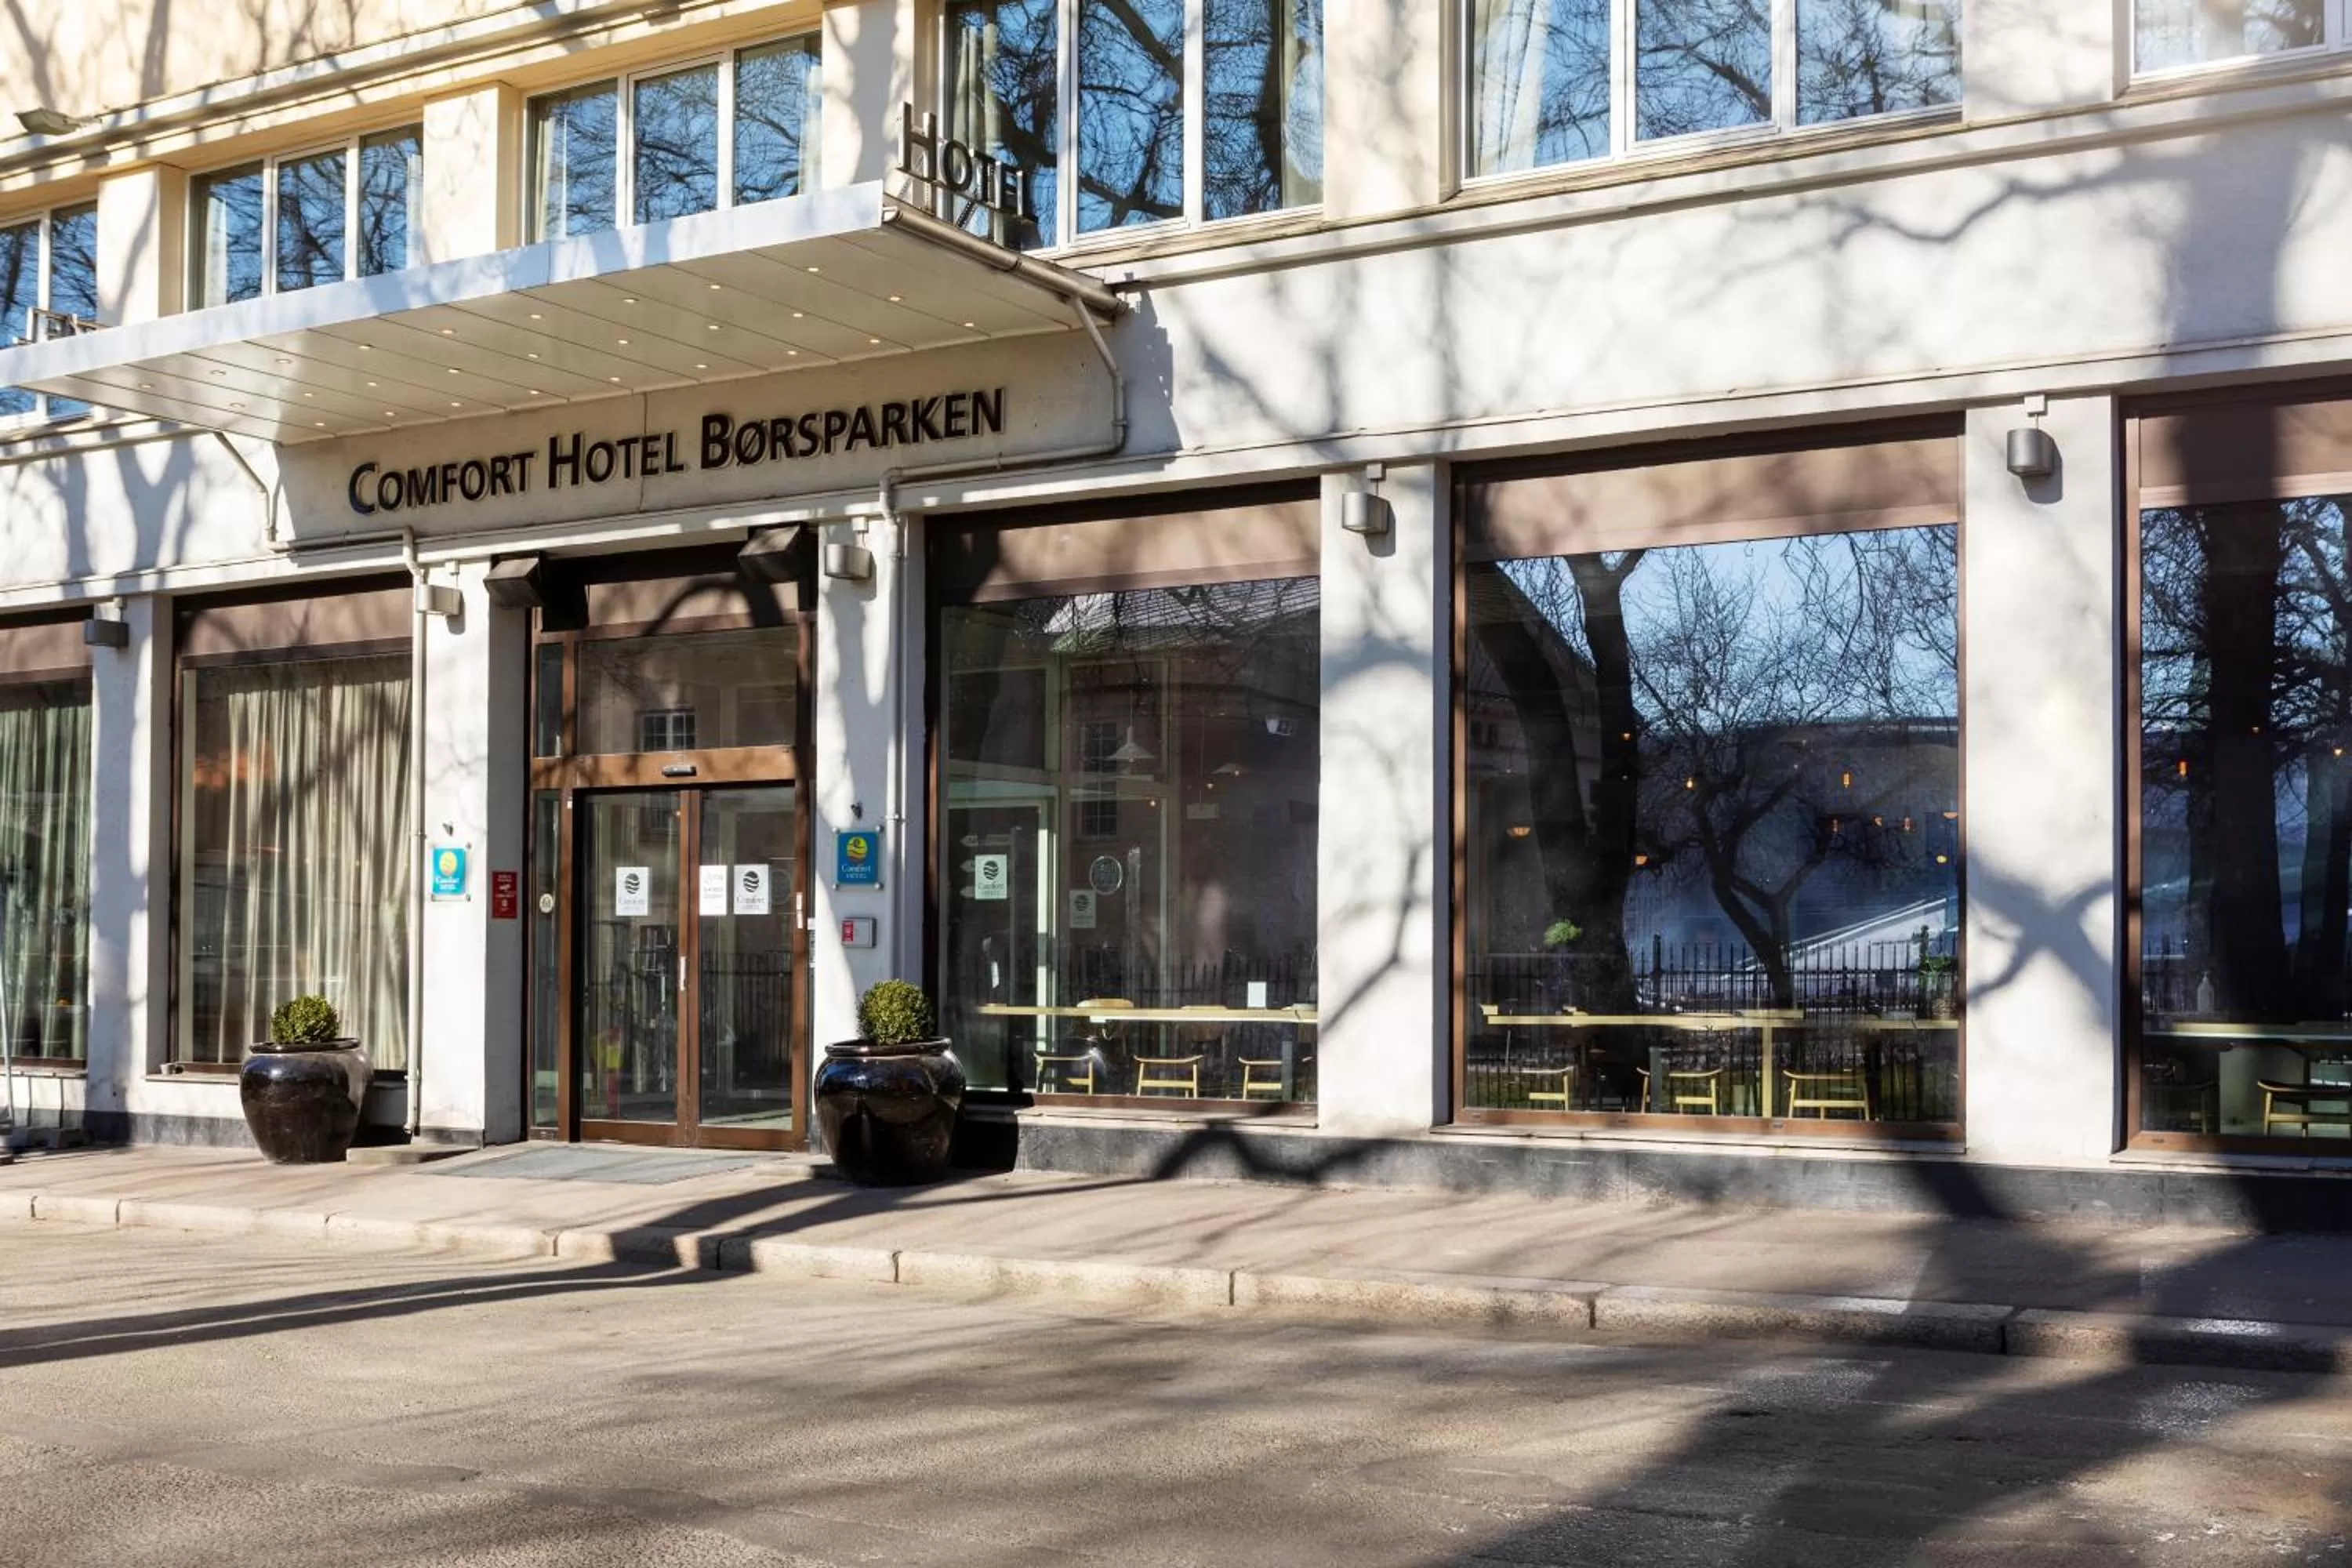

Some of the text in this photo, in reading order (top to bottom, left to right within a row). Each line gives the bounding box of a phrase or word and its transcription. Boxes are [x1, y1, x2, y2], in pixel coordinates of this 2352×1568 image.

[348, 388, 1004, 514] COMFORT HOTEL BØRSPARKEN
